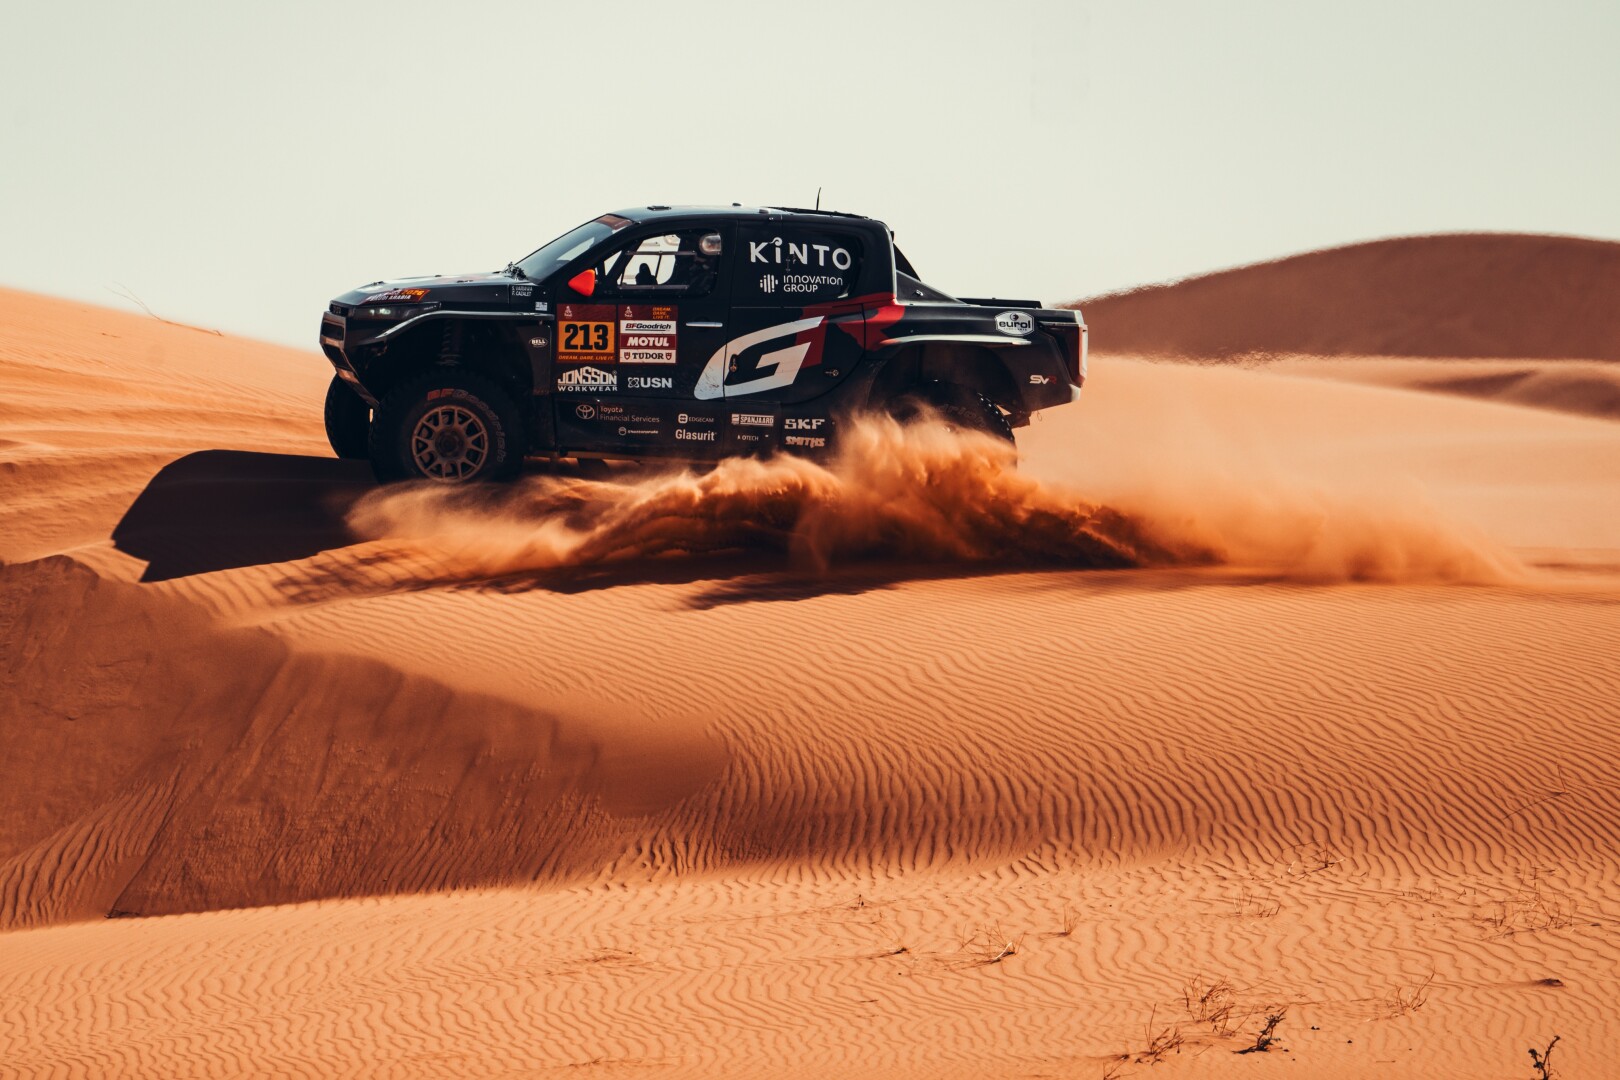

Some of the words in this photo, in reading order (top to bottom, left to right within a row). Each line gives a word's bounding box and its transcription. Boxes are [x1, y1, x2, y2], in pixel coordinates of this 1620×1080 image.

[783, 275, 843, 285] INNOVATION
[783, 284, 819, 293] GROUP
[999, 320, 1031, 328] eurol
[564, 323, 609, 350] 213
[627, 336, 670, 347] MOTUL
[632, 352, 664, 360] TUDOR
[557, 366, 617, 385] JONSSON
[640, 377, 673, 389] USN
[600, 406, 623, 414] Toyota
[600, 415, 630, 423] Financial
[631, 415, 660, 423] Services
[740, 415, 774, 424] SPANJAARD
[784, 418, 826, 430] SKF
[675, 429, 715, 441] Glasurit
[785, 435, 825, 448] SMITHS
